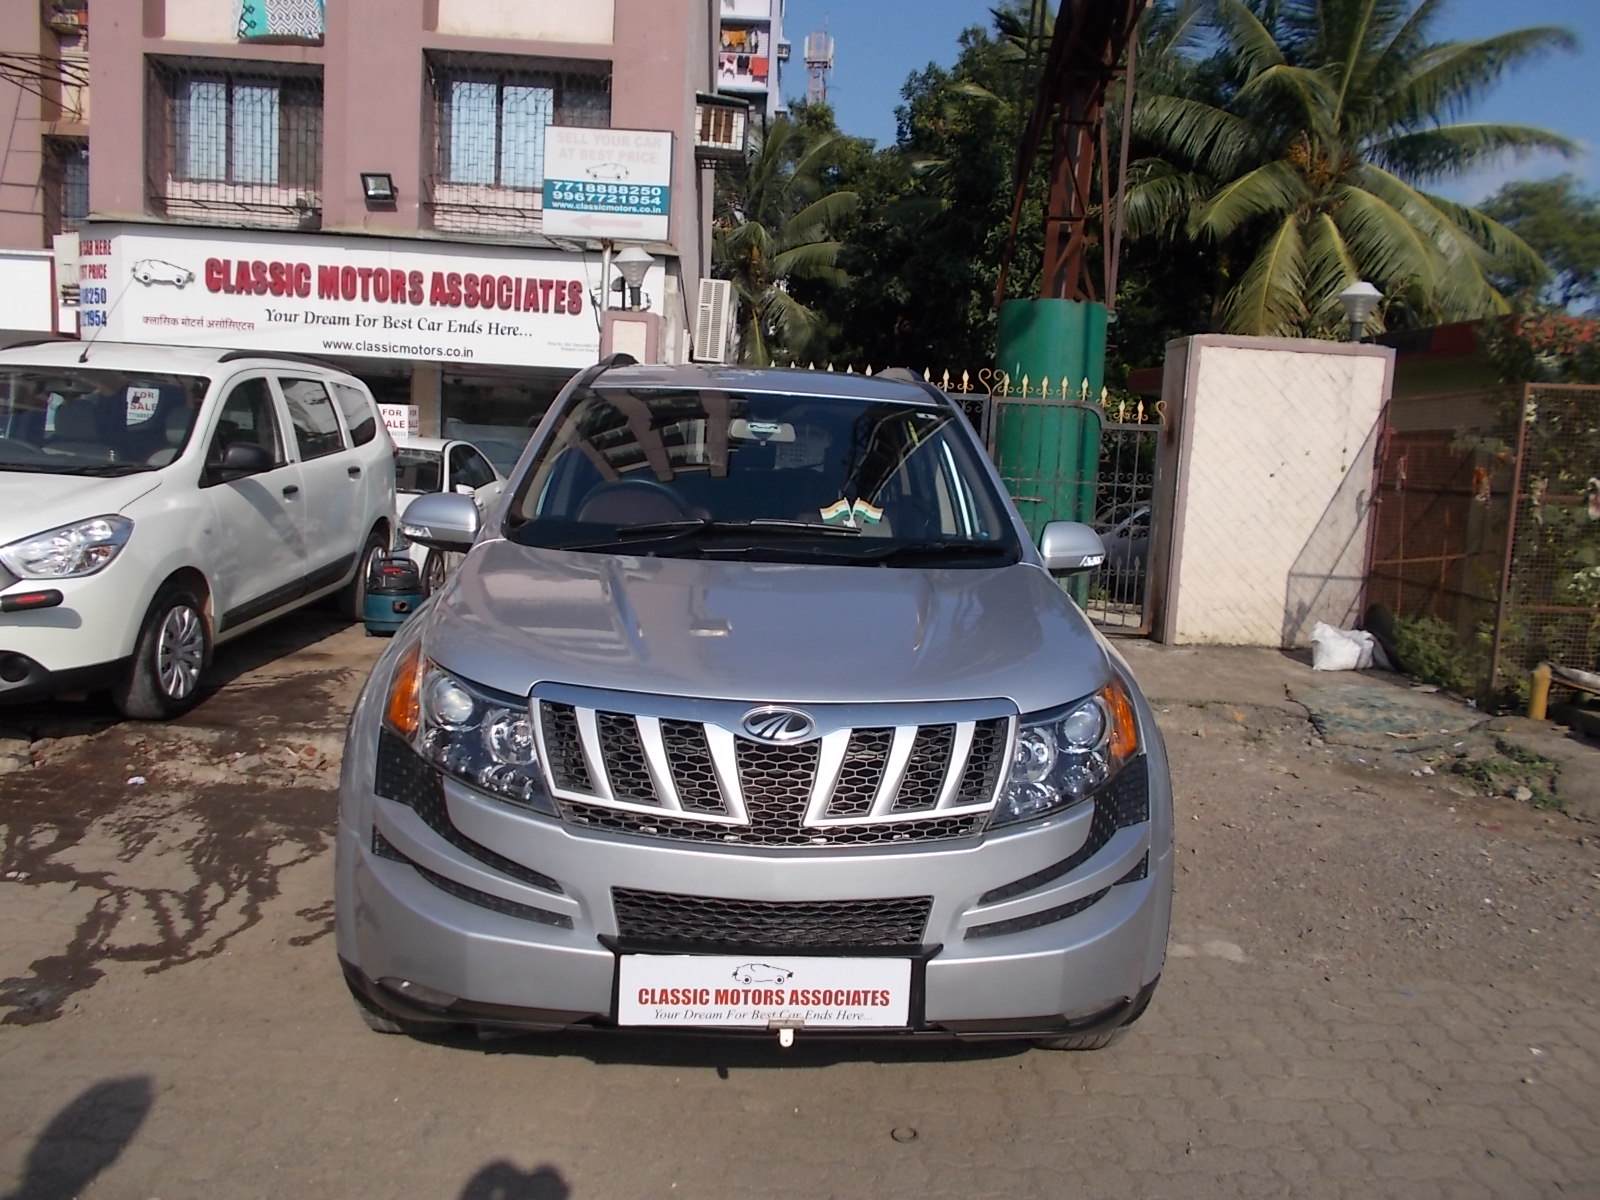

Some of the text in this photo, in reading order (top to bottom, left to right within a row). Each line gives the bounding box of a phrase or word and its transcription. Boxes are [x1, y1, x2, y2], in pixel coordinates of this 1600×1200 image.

[556, 131, 662, 148] SELL YOUR CAR
[558, 146, 658, 163] AT BEST PRICE
[552, 181, 661, 196] 7718888250
[552, 190, 661, 205] 9967721954
[552, 201, 661, 213] www.classicmotors.co.in
[205, 257, 583, 316] CLASSIC MOTORS ASSOCIATES
[265, 308, 532, 337] Your Dream For Best Car Ends Here...
[322, 340, 474, 358] www.classicmotors.co.in
[134, 391, 154, 399] FOR
[130, 402, 157, 411] SALE
[382, 408, 402, 417] FOR
[386, 420, 405, 429] ALE
[638, 988, 890, 1007] CLASSIC MOTORS ASSOCIATES
[655, 1008, 681, 1020] Your
[683, 1009, 722, 1020] Dream
[726, 1009, 749, 1020] For
[751, 1009, 776, 1020] Best
[804, 1009, 832, 1020] Ends
